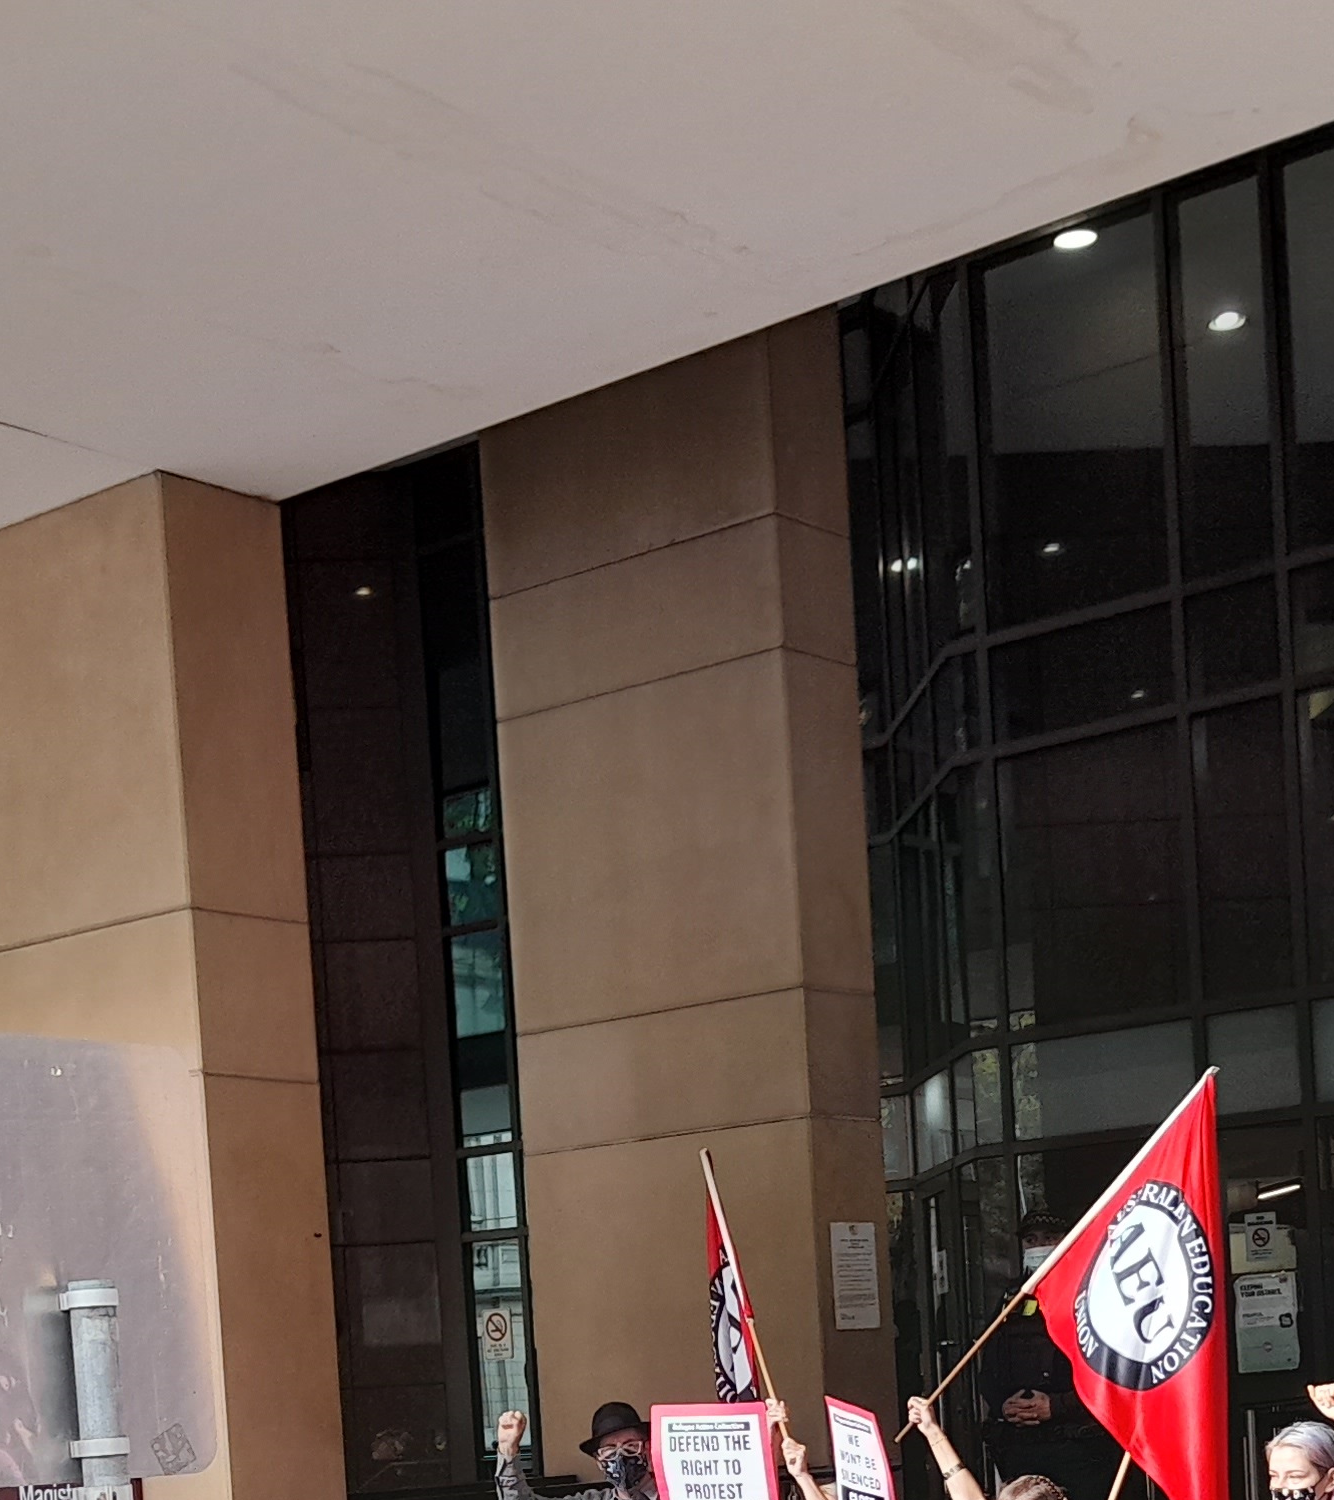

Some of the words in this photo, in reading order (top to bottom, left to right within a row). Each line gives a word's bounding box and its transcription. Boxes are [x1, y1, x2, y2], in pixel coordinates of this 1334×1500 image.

[1150, 1236, 1212, 1384] EDUCATION
[670, 1435, 719, 1452] DEFEND
[726, 1434, 751, 1449] THE
[848, 1435, 859, 1447] WE
[681, 1460, 719, 1475] RIGHT
[723, 1459, 741, 1474] TO
[841, 1469, 881, 1490] SILENCED
[685, 1483, 743, 1500] PROTEST
